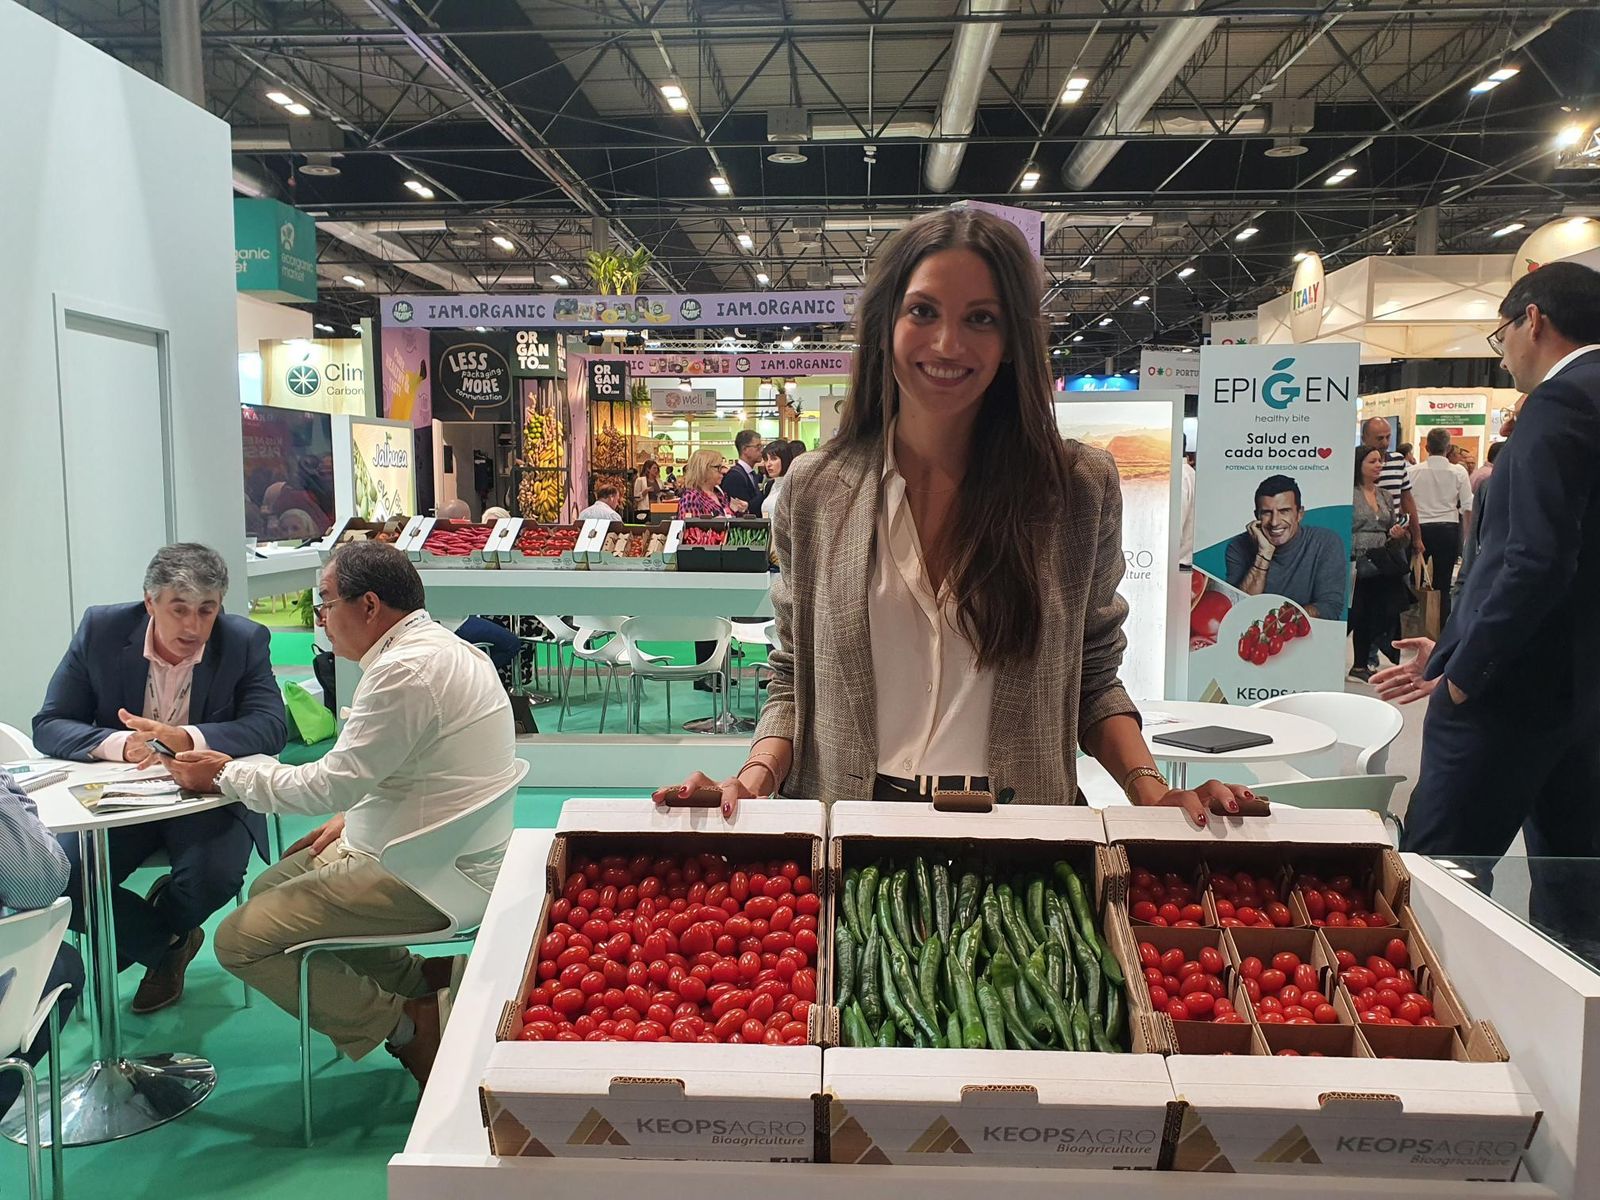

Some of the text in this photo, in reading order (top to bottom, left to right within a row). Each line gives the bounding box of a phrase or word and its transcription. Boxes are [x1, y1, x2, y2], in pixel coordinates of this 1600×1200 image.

[1293, 281, 1320, 310] ITALY
[516, 330, 538, 344] OR
[516, 344, 550, 357] GAN
[448, 351, 488, 372] LESS
[594, 364, 611, 375] OR
[462, 377, 500, 394] MORE
[594, 374, 620, 384] GAN
[455, 388, 503, 400] communication
[1214, 372, 1350, 410] EPIGEN
[1255, 414, 1310, 423] healthy bite
[1246, 432, 1310, 444] Salud en
[1224, 446, 1263, 458] cada
[636, 1118, 807, 1136] KEOPSAGRO
[712, 1136, 805, 1146] Bioagriculture
[984, 1126, 1156, 1144] KEOPSAGRO
[1056, 1144, 1152, 1156] Bioagriculture
[1336, 1136, 1517, 1156] KEOPSAGRO
